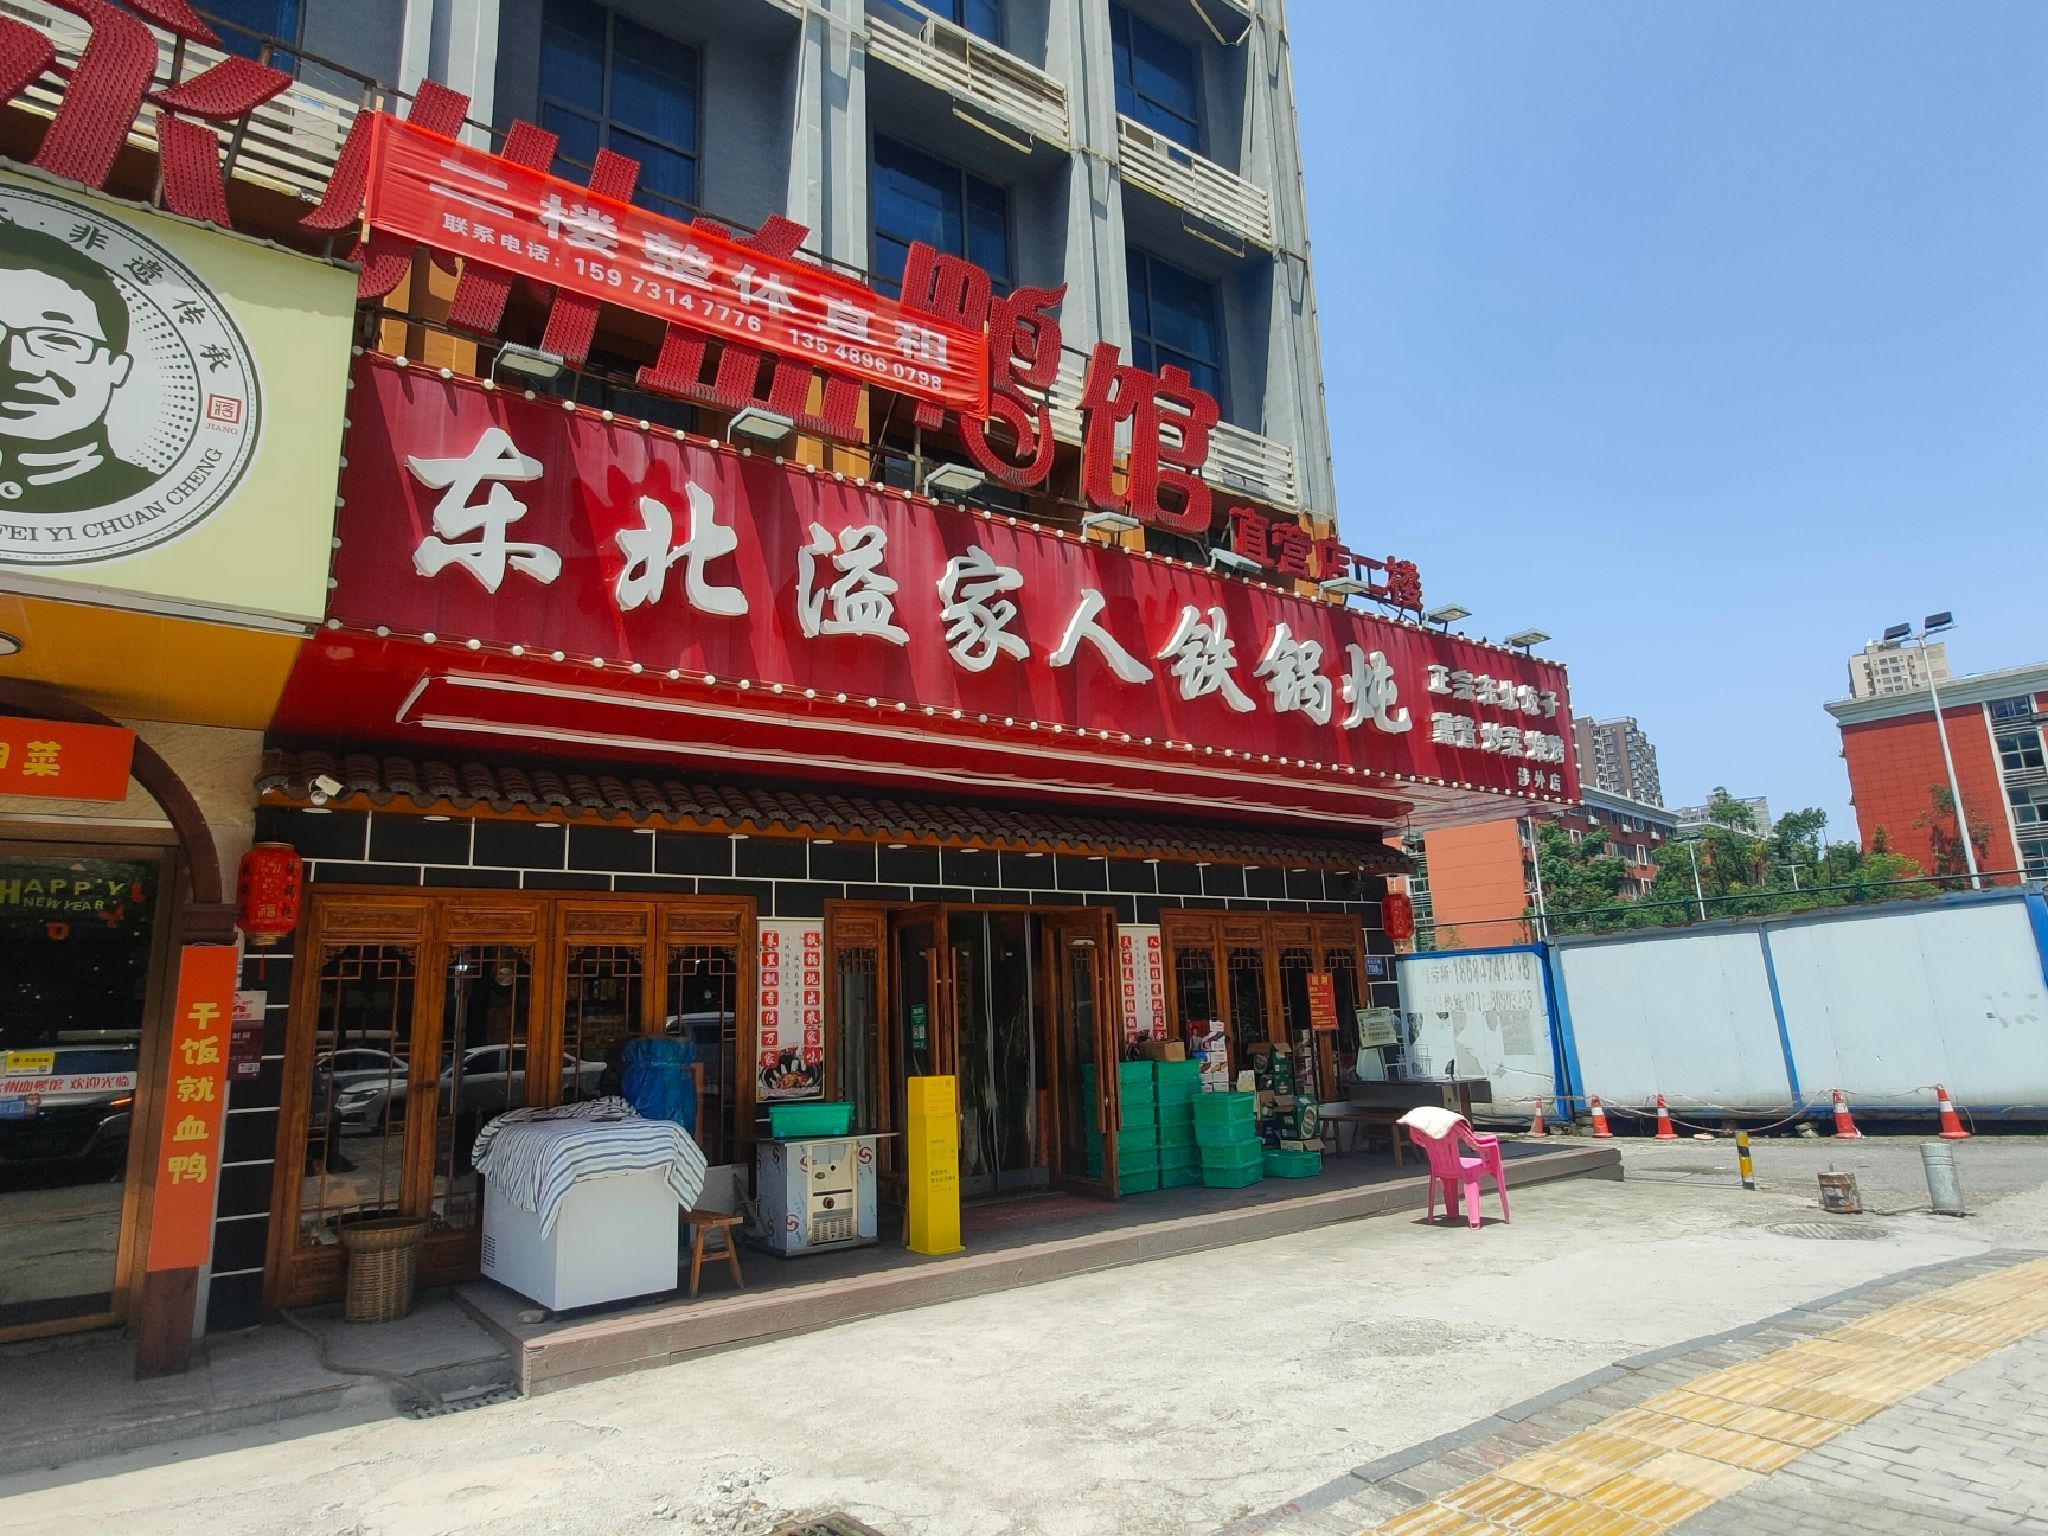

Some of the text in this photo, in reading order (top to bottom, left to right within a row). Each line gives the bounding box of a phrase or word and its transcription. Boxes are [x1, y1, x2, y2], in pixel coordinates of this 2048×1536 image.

[575, 256, 622, 287] 159
[631, 275, 694, 311] 7314
[701, 298, 762, 333] 7776
[789, 327, 829, 355] 135
[833, 343, 889, 373] 4896
[893, 362, 942, 391] 0798
[44, 525, 77, 542] YI
[82, 500, 167, 540] CHUAN
[166, 447, 224, 505] CHENG
[405, 426, 1413, 734] 东北溢家人铁锅炖
[1427, 664, 1561, 719] 正宗东北饺子
[168, 1002, 220, 1185] 干饭就血鸭
